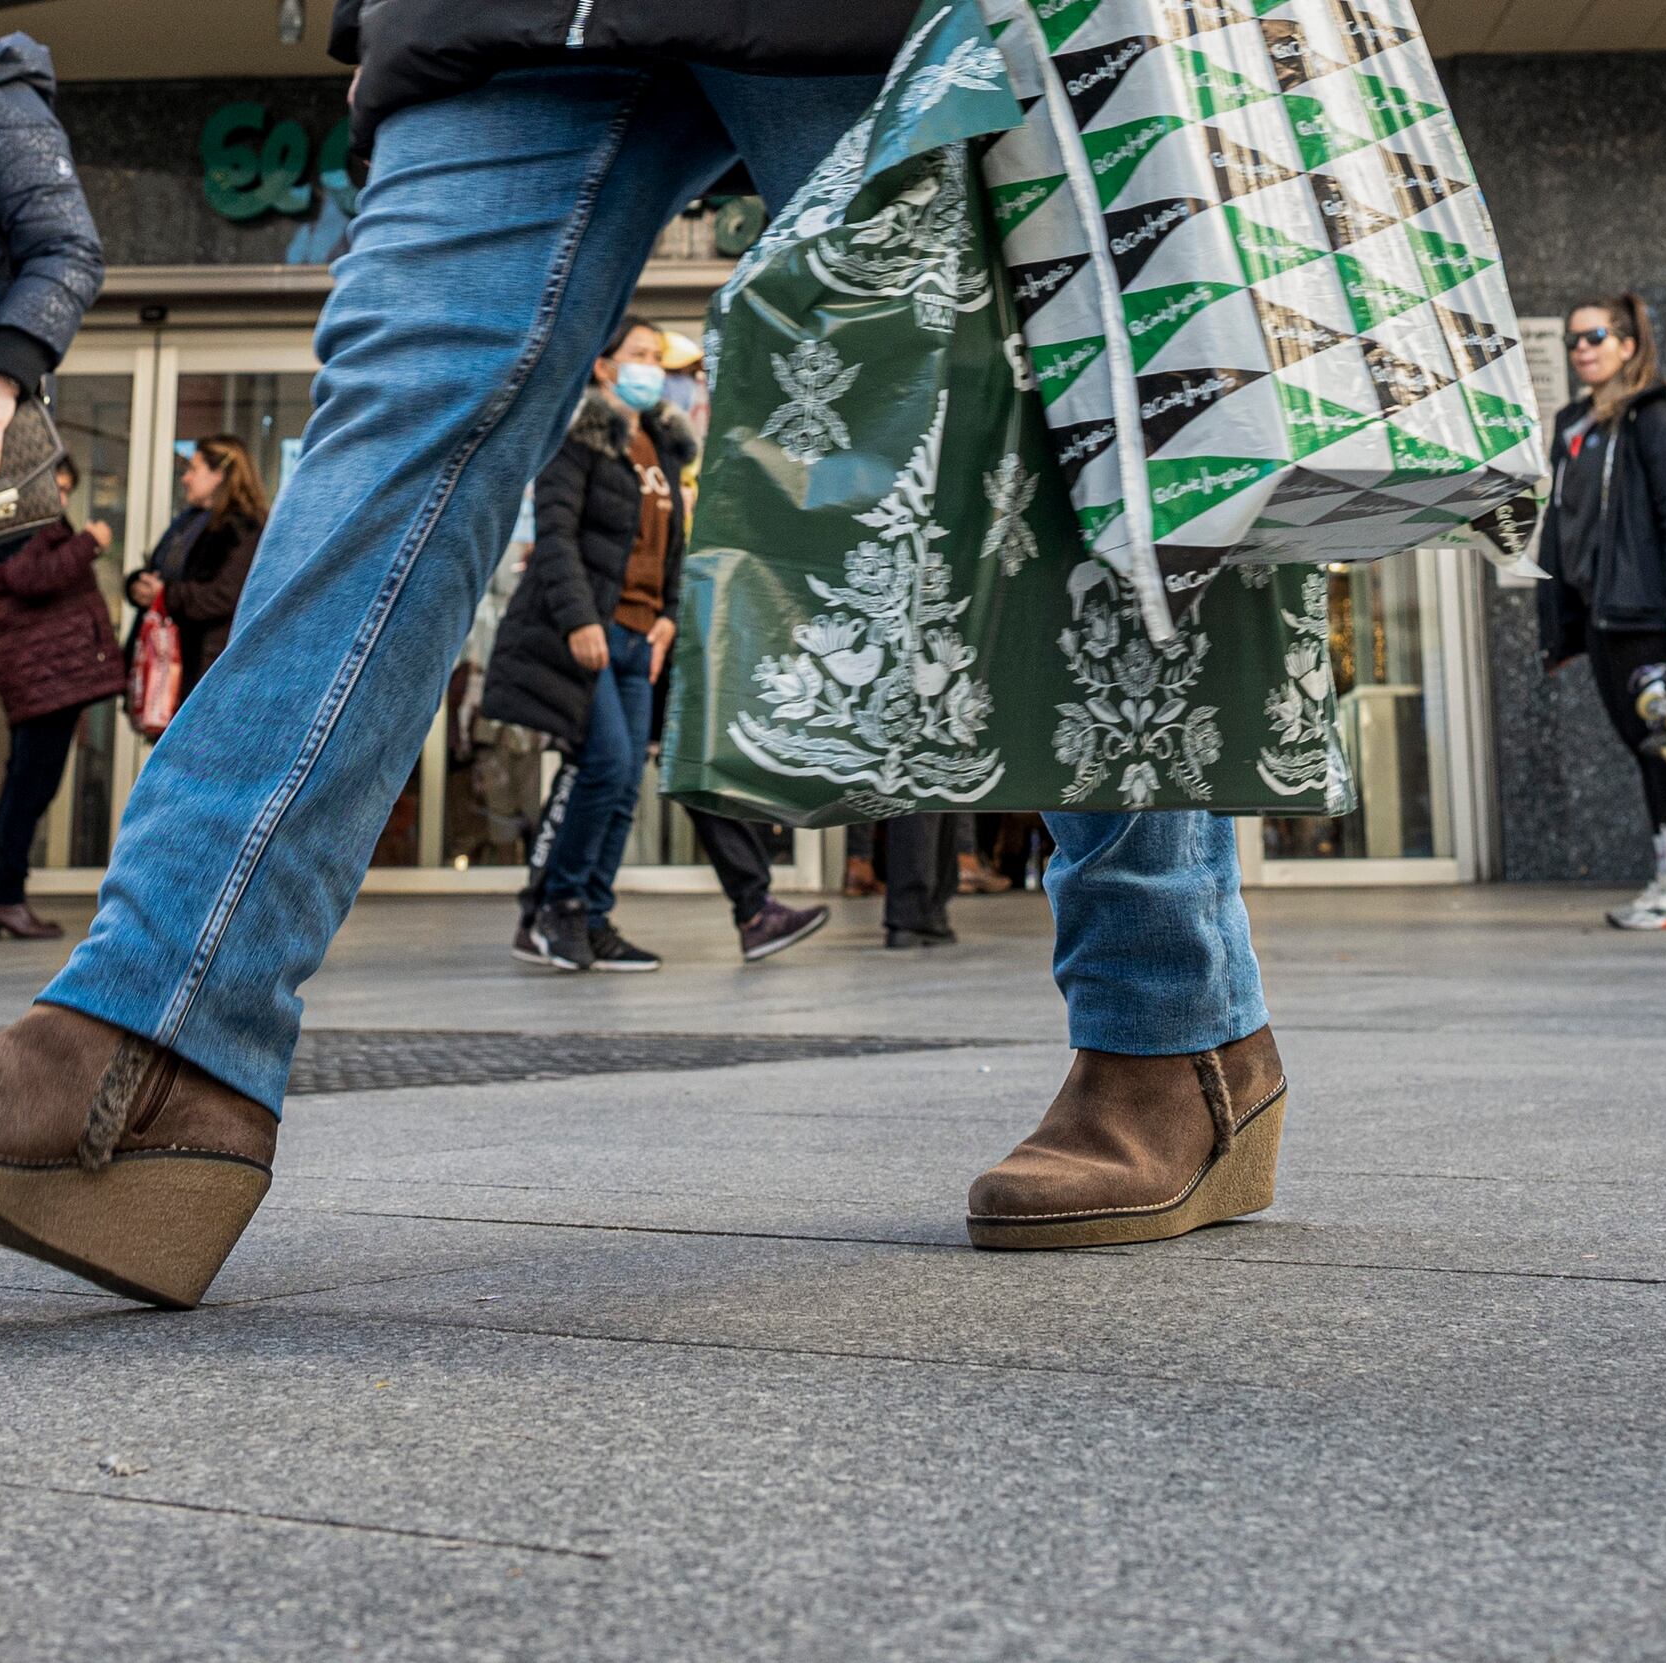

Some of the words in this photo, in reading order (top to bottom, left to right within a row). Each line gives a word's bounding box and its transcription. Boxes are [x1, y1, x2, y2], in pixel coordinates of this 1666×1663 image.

[1066, 80, 1084, 96] El
[201, 102, 312, 221] El
[1110, 238, 1129, 255] El
[1128, 320, 1147, 336] El
[1140, 403, 1157, 419] El
[1182, 374, 1237, 407] Inglés
[1153, 487, 1171, 504] El
[1167, 478, 1203, 498] Corte
[1200, 463, 1260, 495] Inglés
[1165, 574, 1186, 593] El
